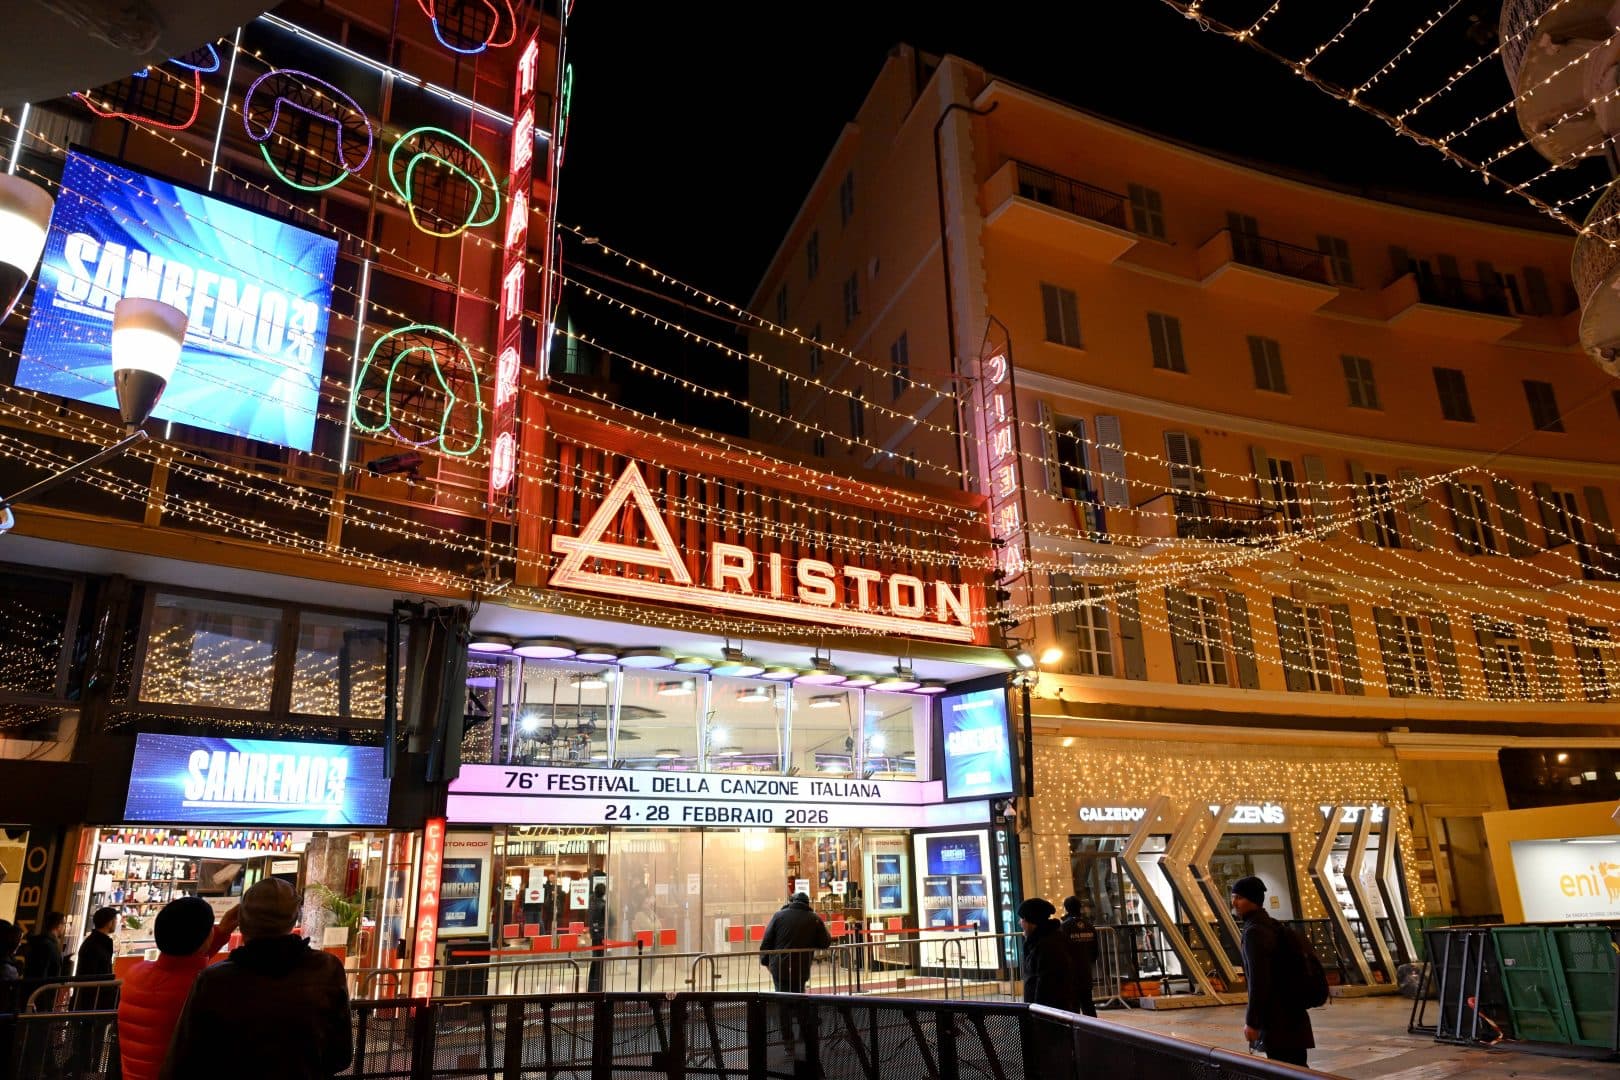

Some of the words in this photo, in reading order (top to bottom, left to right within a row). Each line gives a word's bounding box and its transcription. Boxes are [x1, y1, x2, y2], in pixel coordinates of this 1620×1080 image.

[55, 231, 289, 356] SANREMO
[491, 39, 538, 490] TEATRO
[549, 459, 973, 641] ARISTON
[183, 749, 328, 802] SANREMO
[547, 774, 640, 792] FESTIVAL
[652, 777, 710, 793] DELLA
[721, 778, 799, 796] CANZONE
[811, 781, 881, 798] ITALIANA
[683, 805, 773, 823] FEBBRAIO
[785, 809, 829, 824] 2026
[1079, 807, 1162, 822] CALZEDO
[1208, 801, 1285, 824] TZENIS
[422, 825, 441, 905] CINEMA
[996, 830, 1012, 905] CINEMA
[1559, 864, 1600, 897] eni
[413, 917, 436, 1008] ARISO
